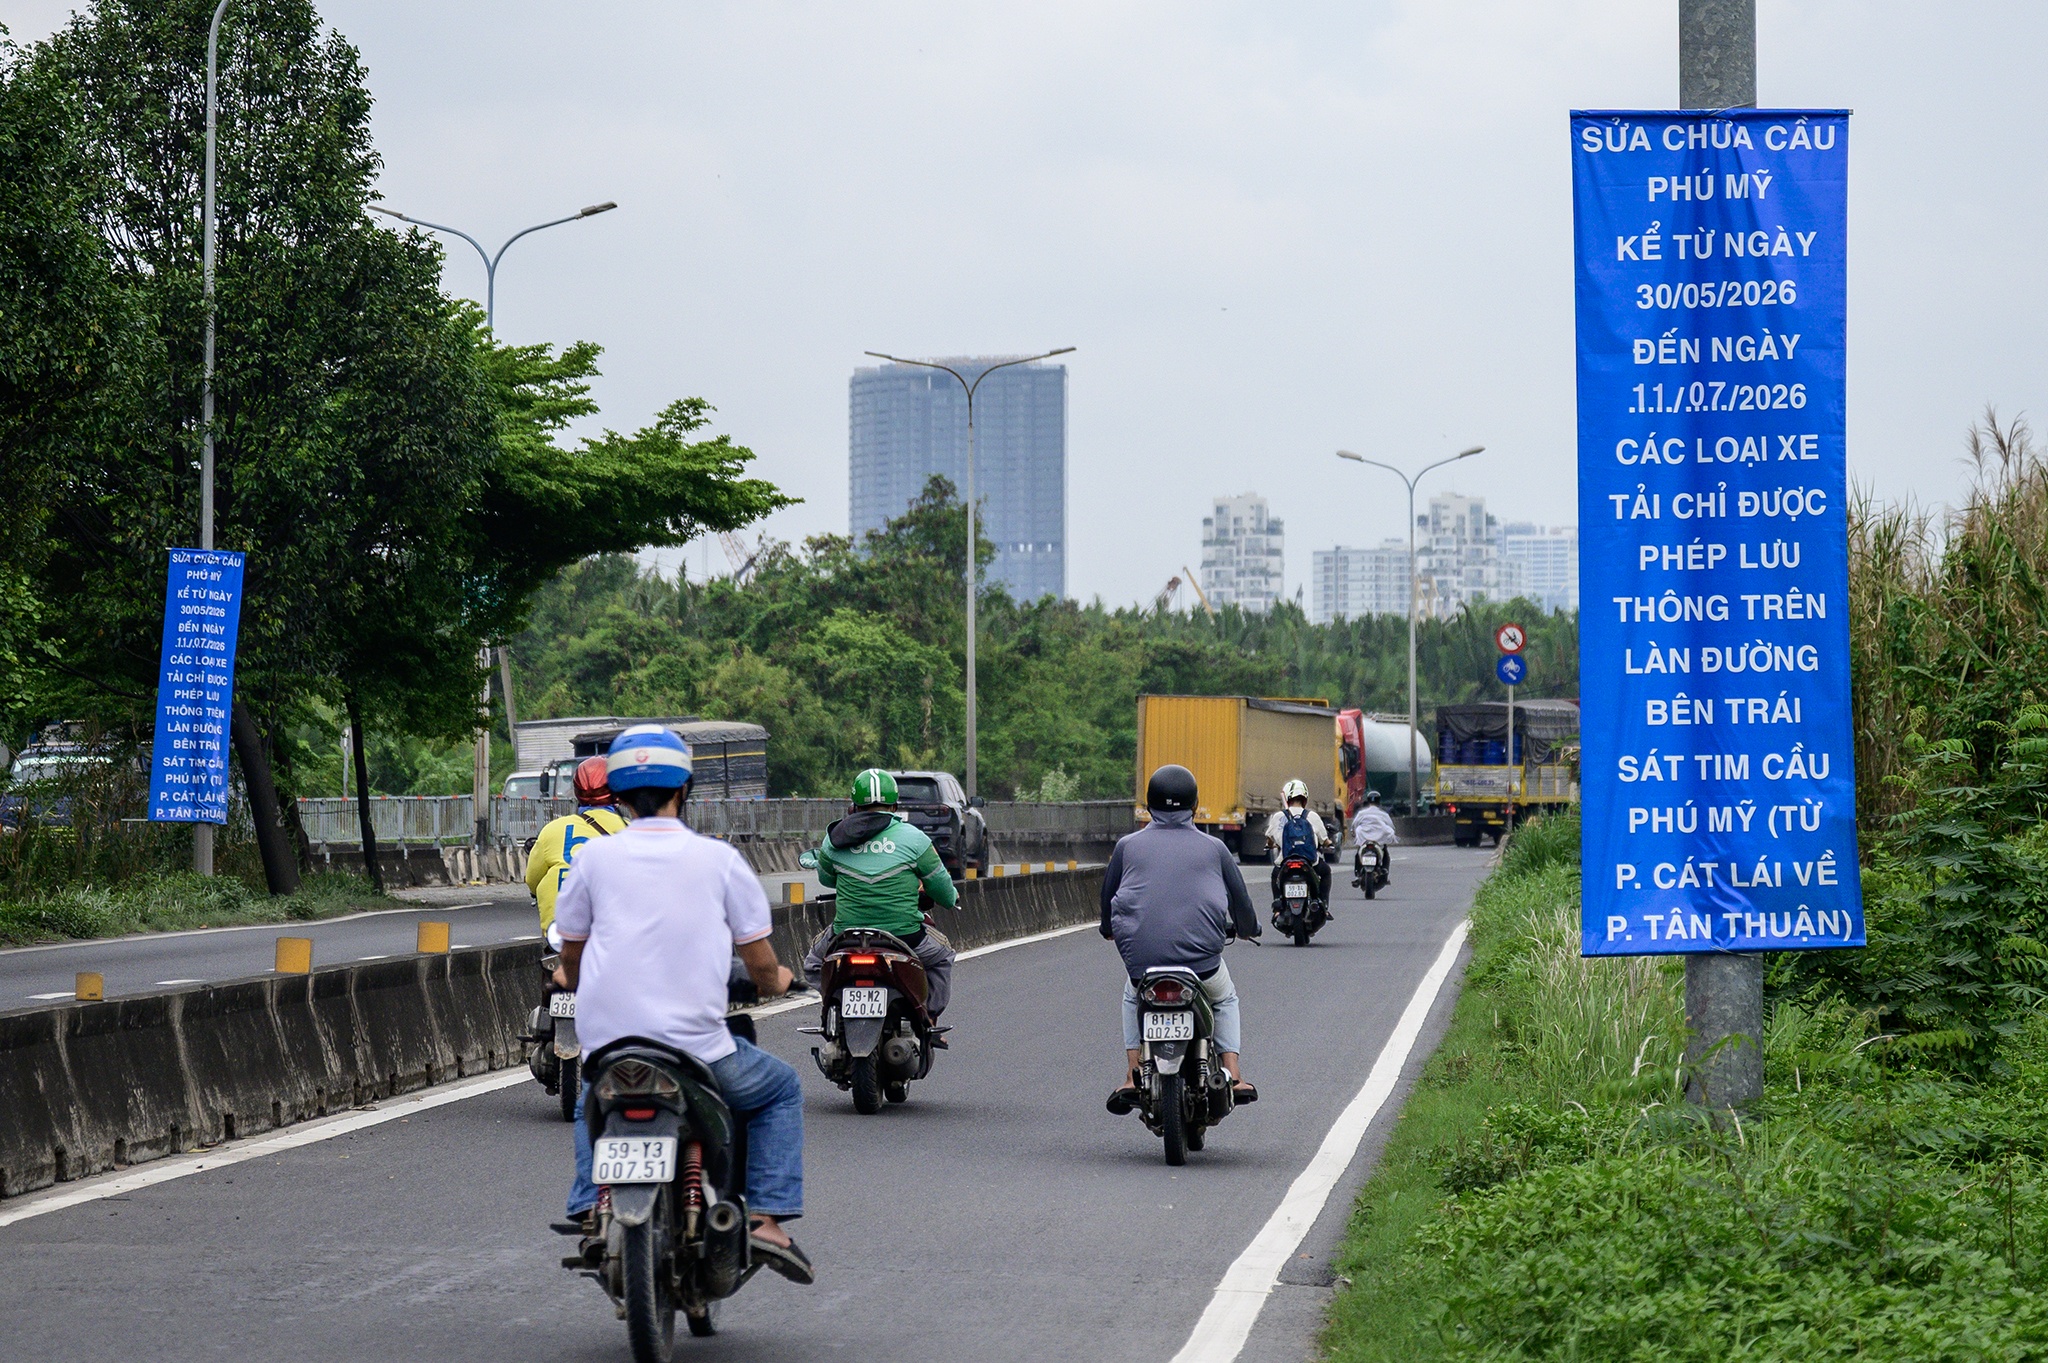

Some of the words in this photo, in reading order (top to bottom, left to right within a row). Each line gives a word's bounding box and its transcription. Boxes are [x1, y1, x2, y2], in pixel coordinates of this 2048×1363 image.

[1582, 115, 1652, 153] SỬA
[1764, 114, 1835, 151] CẦU
[1648, 167, 1714, 202] PHÚ
[1725, 168, 1773, 200] MỸ
[1617, 220, 1662, 261] KỂ
[1672, 226, 1716, 260] TỪ
[1725, 225, 1817, 258] NGÀY
[1636, 279, 1797, 310] 30/05/2026
[1632, 327, 1700, 365] ĐẾN
[1711, 328, 1801, 362] NGÀY
[1615, 431, 1685, 465] CÁC
[1697, 436, 1768, 468] LOẠI
[1777, 434, 1819, 461] XE
[1608, 483, 1660, 520] TẢI
[1672, 481, 1727, 519] CHỈ
[1737, 486, 1827, 522] ĐƯỢC
[1639, 543, 1727, 571] PHÉP
[1739, 538, 1800, 569] LƯU
[192, 588, 207, 598] TỪ
[1612, 589, 1729, 623] THÔNG
[1740, 586, 1826, 620] TRÊN
[178, 620, 199, 632] ĐẾN
[170, 653, 192, 664] CÁC
[216, 658, 227, 668] XE
[1625, 640, 1690, 674] LÀN
[1701, 639, 1819, 673] ĐƯỜNG
[165, 704, 202, 716] THÔNG
[1646, 692, 1714, 726] BÊN
[1724, 690, 1801, 724] TRÁI
[168, 721, 189, 732] LÀN
[174, 738, 196, 749] BÊN
[163, 756, 185, 767] SÁT
[1618, 748, 1685, 783] SÁT
[1694, 754, 1749, 781] TIM
[1762, 742, 1830, 780] CẦU
[165, 772, 189, 784] PHÚ
[160, 792, 169, 801] P.
[173, 791, 195, 801] CÁT
[198, 791, 215, 802] LÁI
[156, 809, 165, 817] P.
[168, 807, 191, 818] TÂN
[1629, 799, 1697, 834] PHÚ
[1708, 799, 1757, 833] MỸ
[1768, 797, 1823, 839] (TỪ
[1616, 863, 1641, 890] P.
[1653, 855, 1719, 890] CÁT
[1730, 854, 1782, 888] LÁI
[1792, 849, 1838, 887] VỀ
[1607, 915, 1633, 942] P.
[1642, 907, 1712, 941] TÂN
[1722, 904, 1852, 942] THUẬN)
[845, 1003, 883, 1016] 240.44
[1152, 1013, 1184, 1026] 81-F1
[1148, 1026, 1190, 1039] 002.52
[608, 1142, 663, 1160] 59-Y3
[598, 1161, 666, 1180] 007.51
